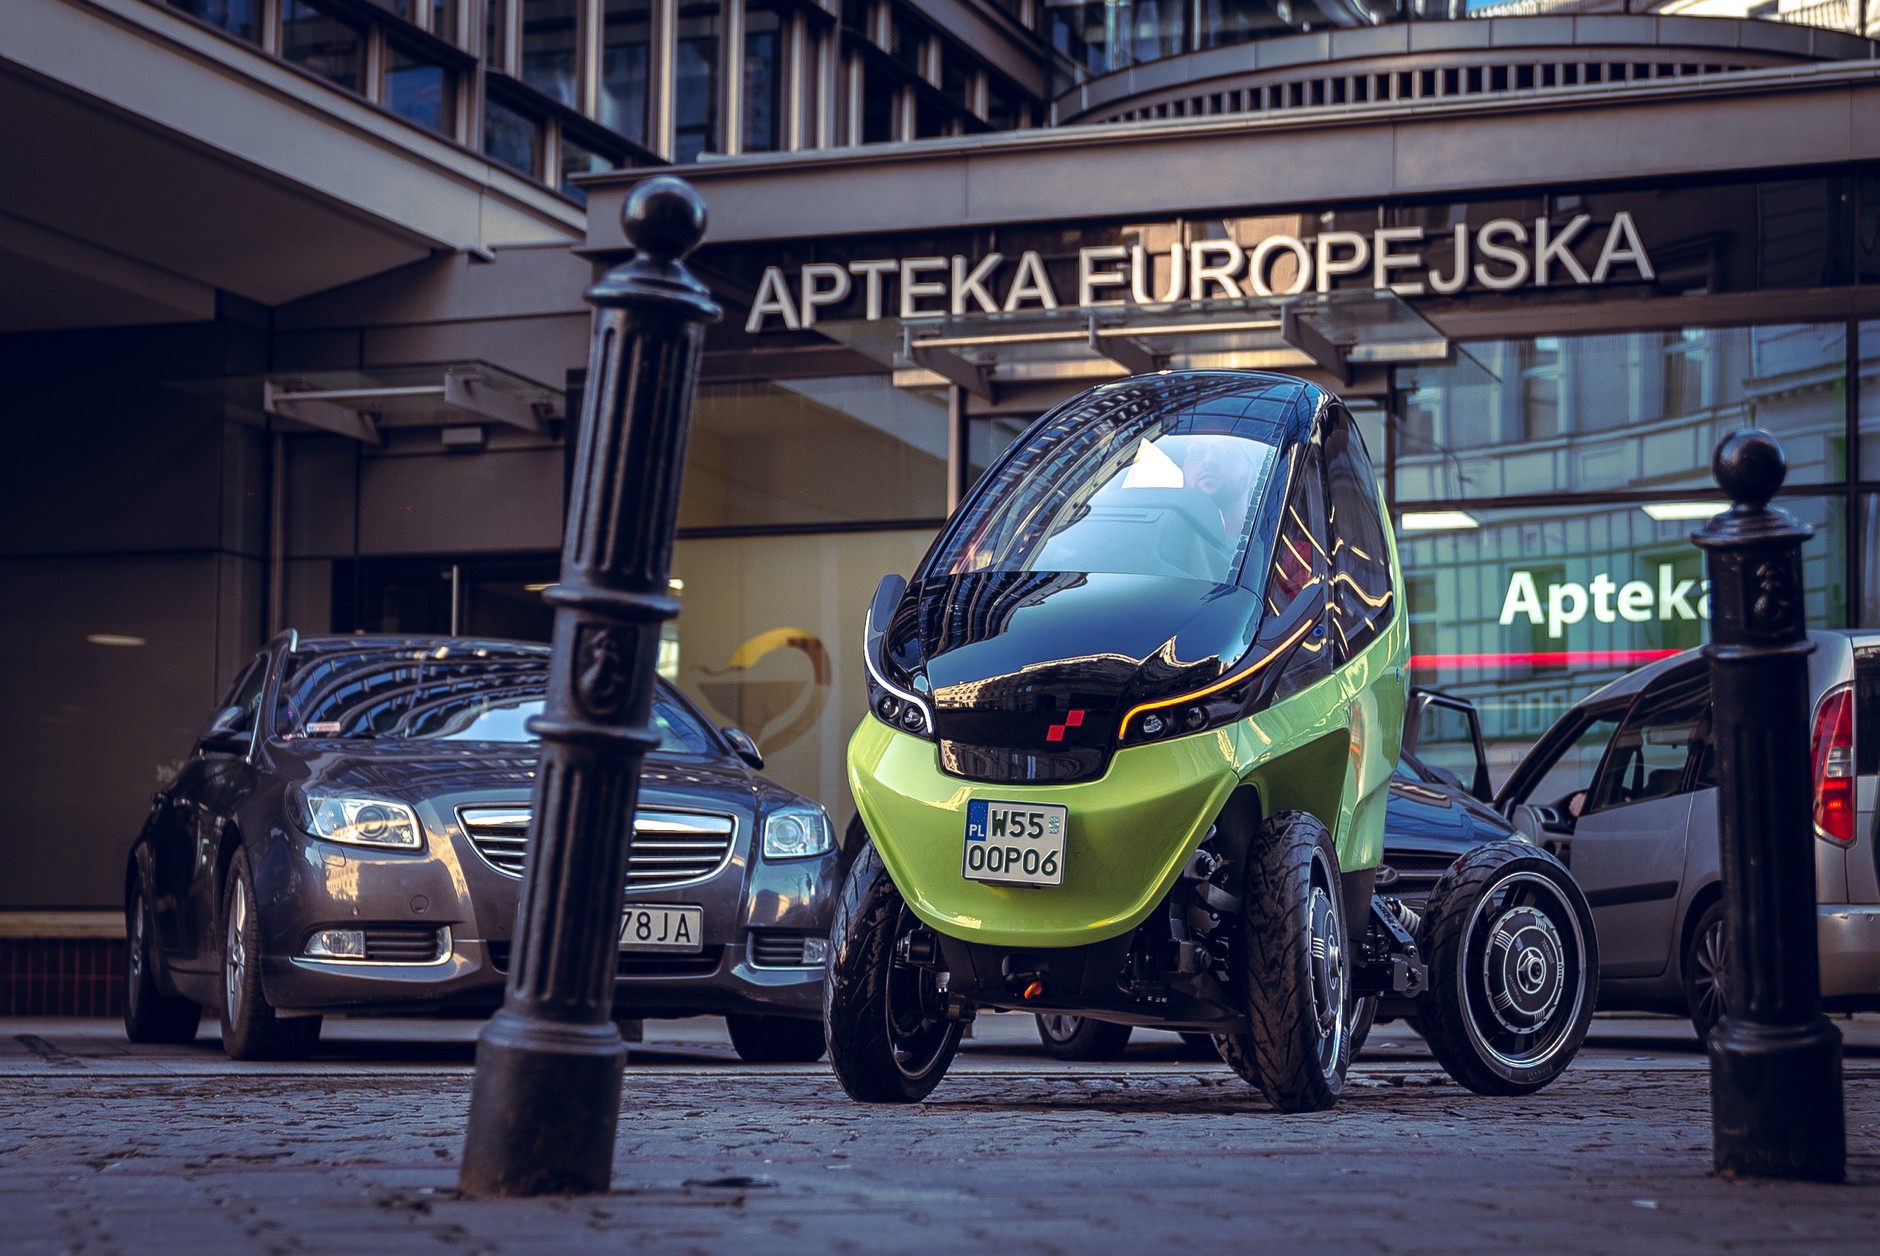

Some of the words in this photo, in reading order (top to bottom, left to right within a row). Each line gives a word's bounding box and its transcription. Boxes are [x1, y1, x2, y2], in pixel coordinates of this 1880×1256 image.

[745, 250, 1059, 333] APTEKA
[1078, 211, 1656, 310] EUROPEJSKA
[968, 824, 985, 838] PL
[991, 809, 1045, 840] W55
[620, 911, 692, 943] 78JA
